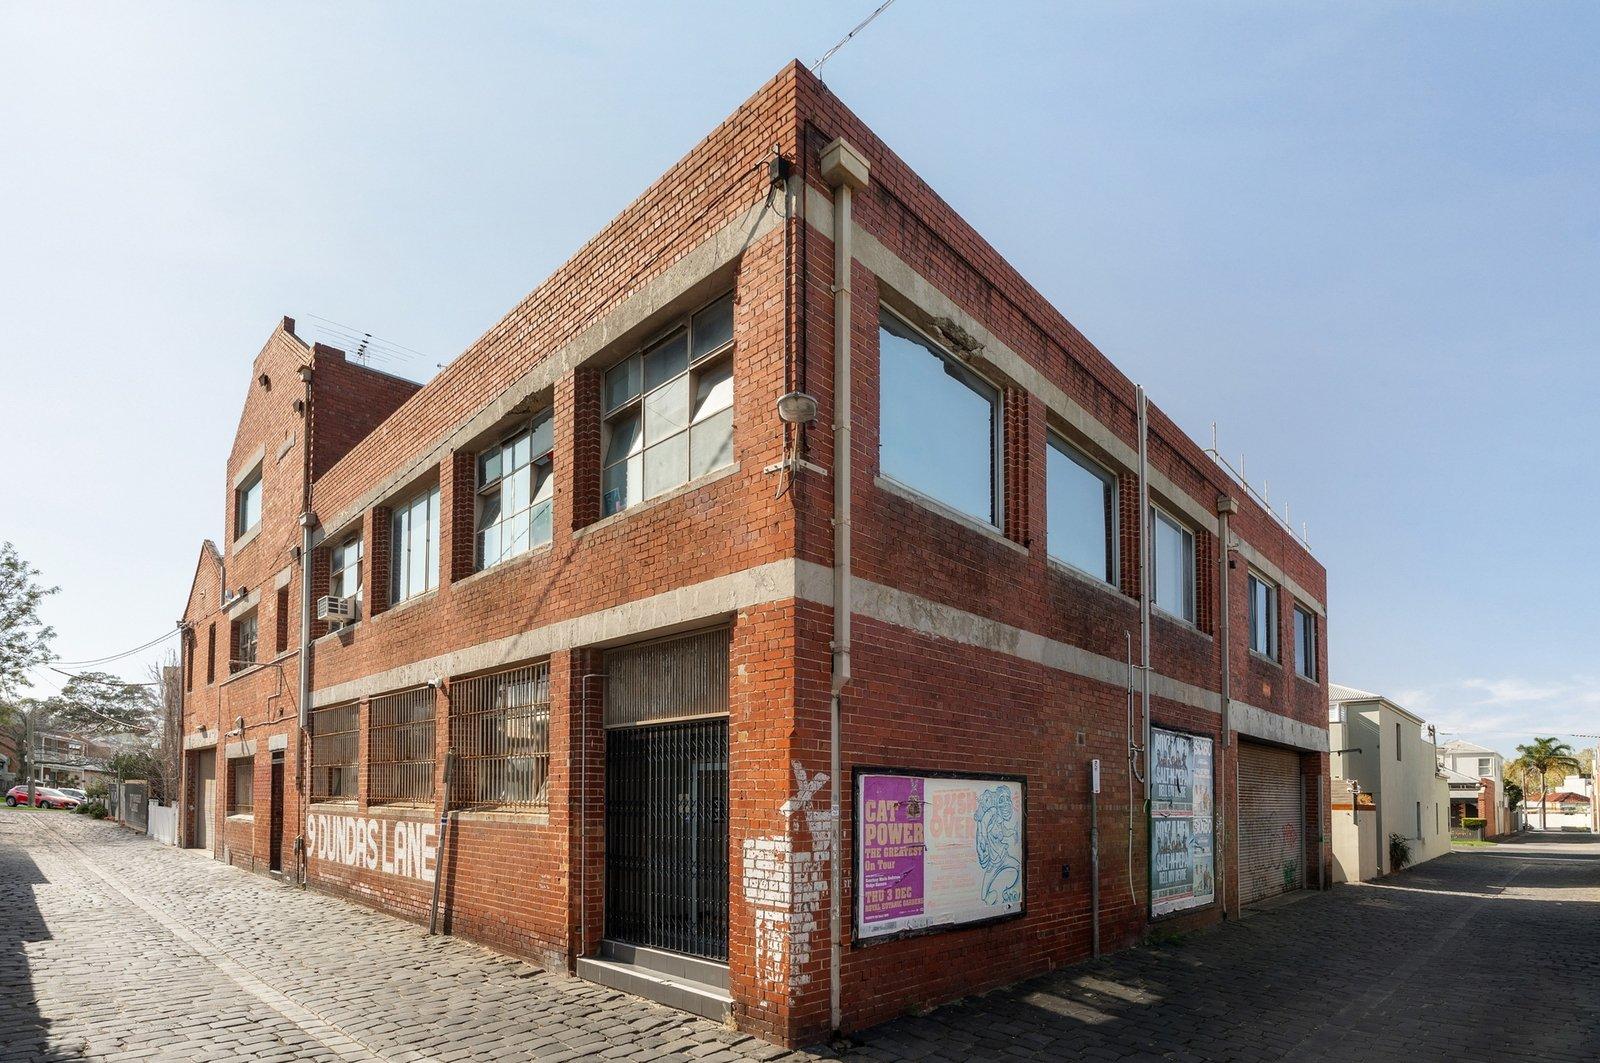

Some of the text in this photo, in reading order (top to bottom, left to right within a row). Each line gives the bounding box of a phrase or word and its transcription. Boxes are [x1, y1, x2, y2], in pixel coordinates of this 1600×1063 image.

[865, 800, 899, 822] CAT
[865, 823, 925, 846] POWER
[306, 813, 437, 882] 9 DUNDAS LANE
[865, 846, 922, 859] THE GREATEST
[865, 860, 895, 871] On Tour
[865, 887, 912, 904] THU 3 DEC
